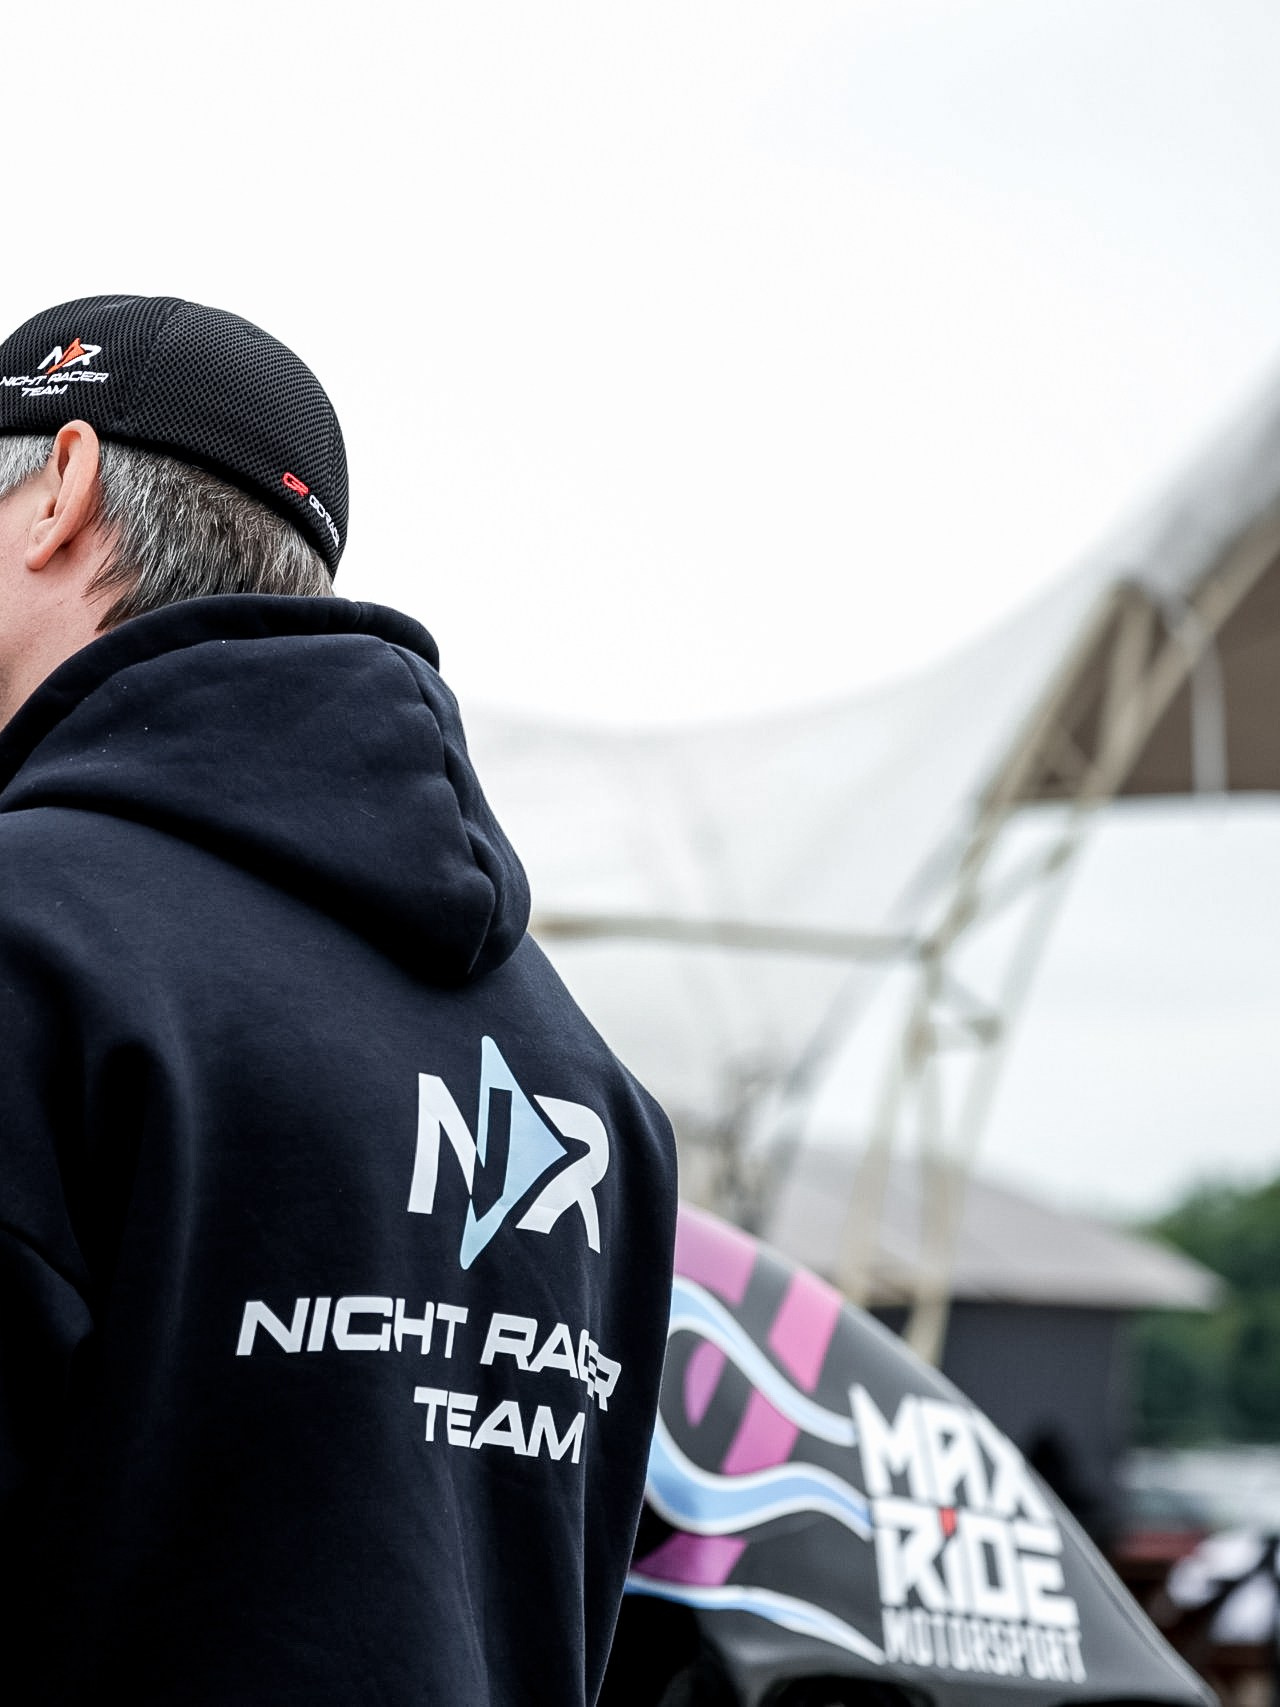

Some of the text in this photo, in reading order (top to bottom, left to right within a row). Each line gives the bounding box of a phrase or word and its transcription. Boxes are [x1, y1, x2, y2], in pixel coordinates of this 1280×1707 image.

[21, 384, 68, 398] TEAM
[47, 371, 109, 384] RACER
[236, 1296, 469, 1359] NIGHT
[414, 1386, 587, 1464] TEAM
[849, 1383, 1054, 1520] MAX
[881, 1606, 1087, 1684] MOTORSPORT
